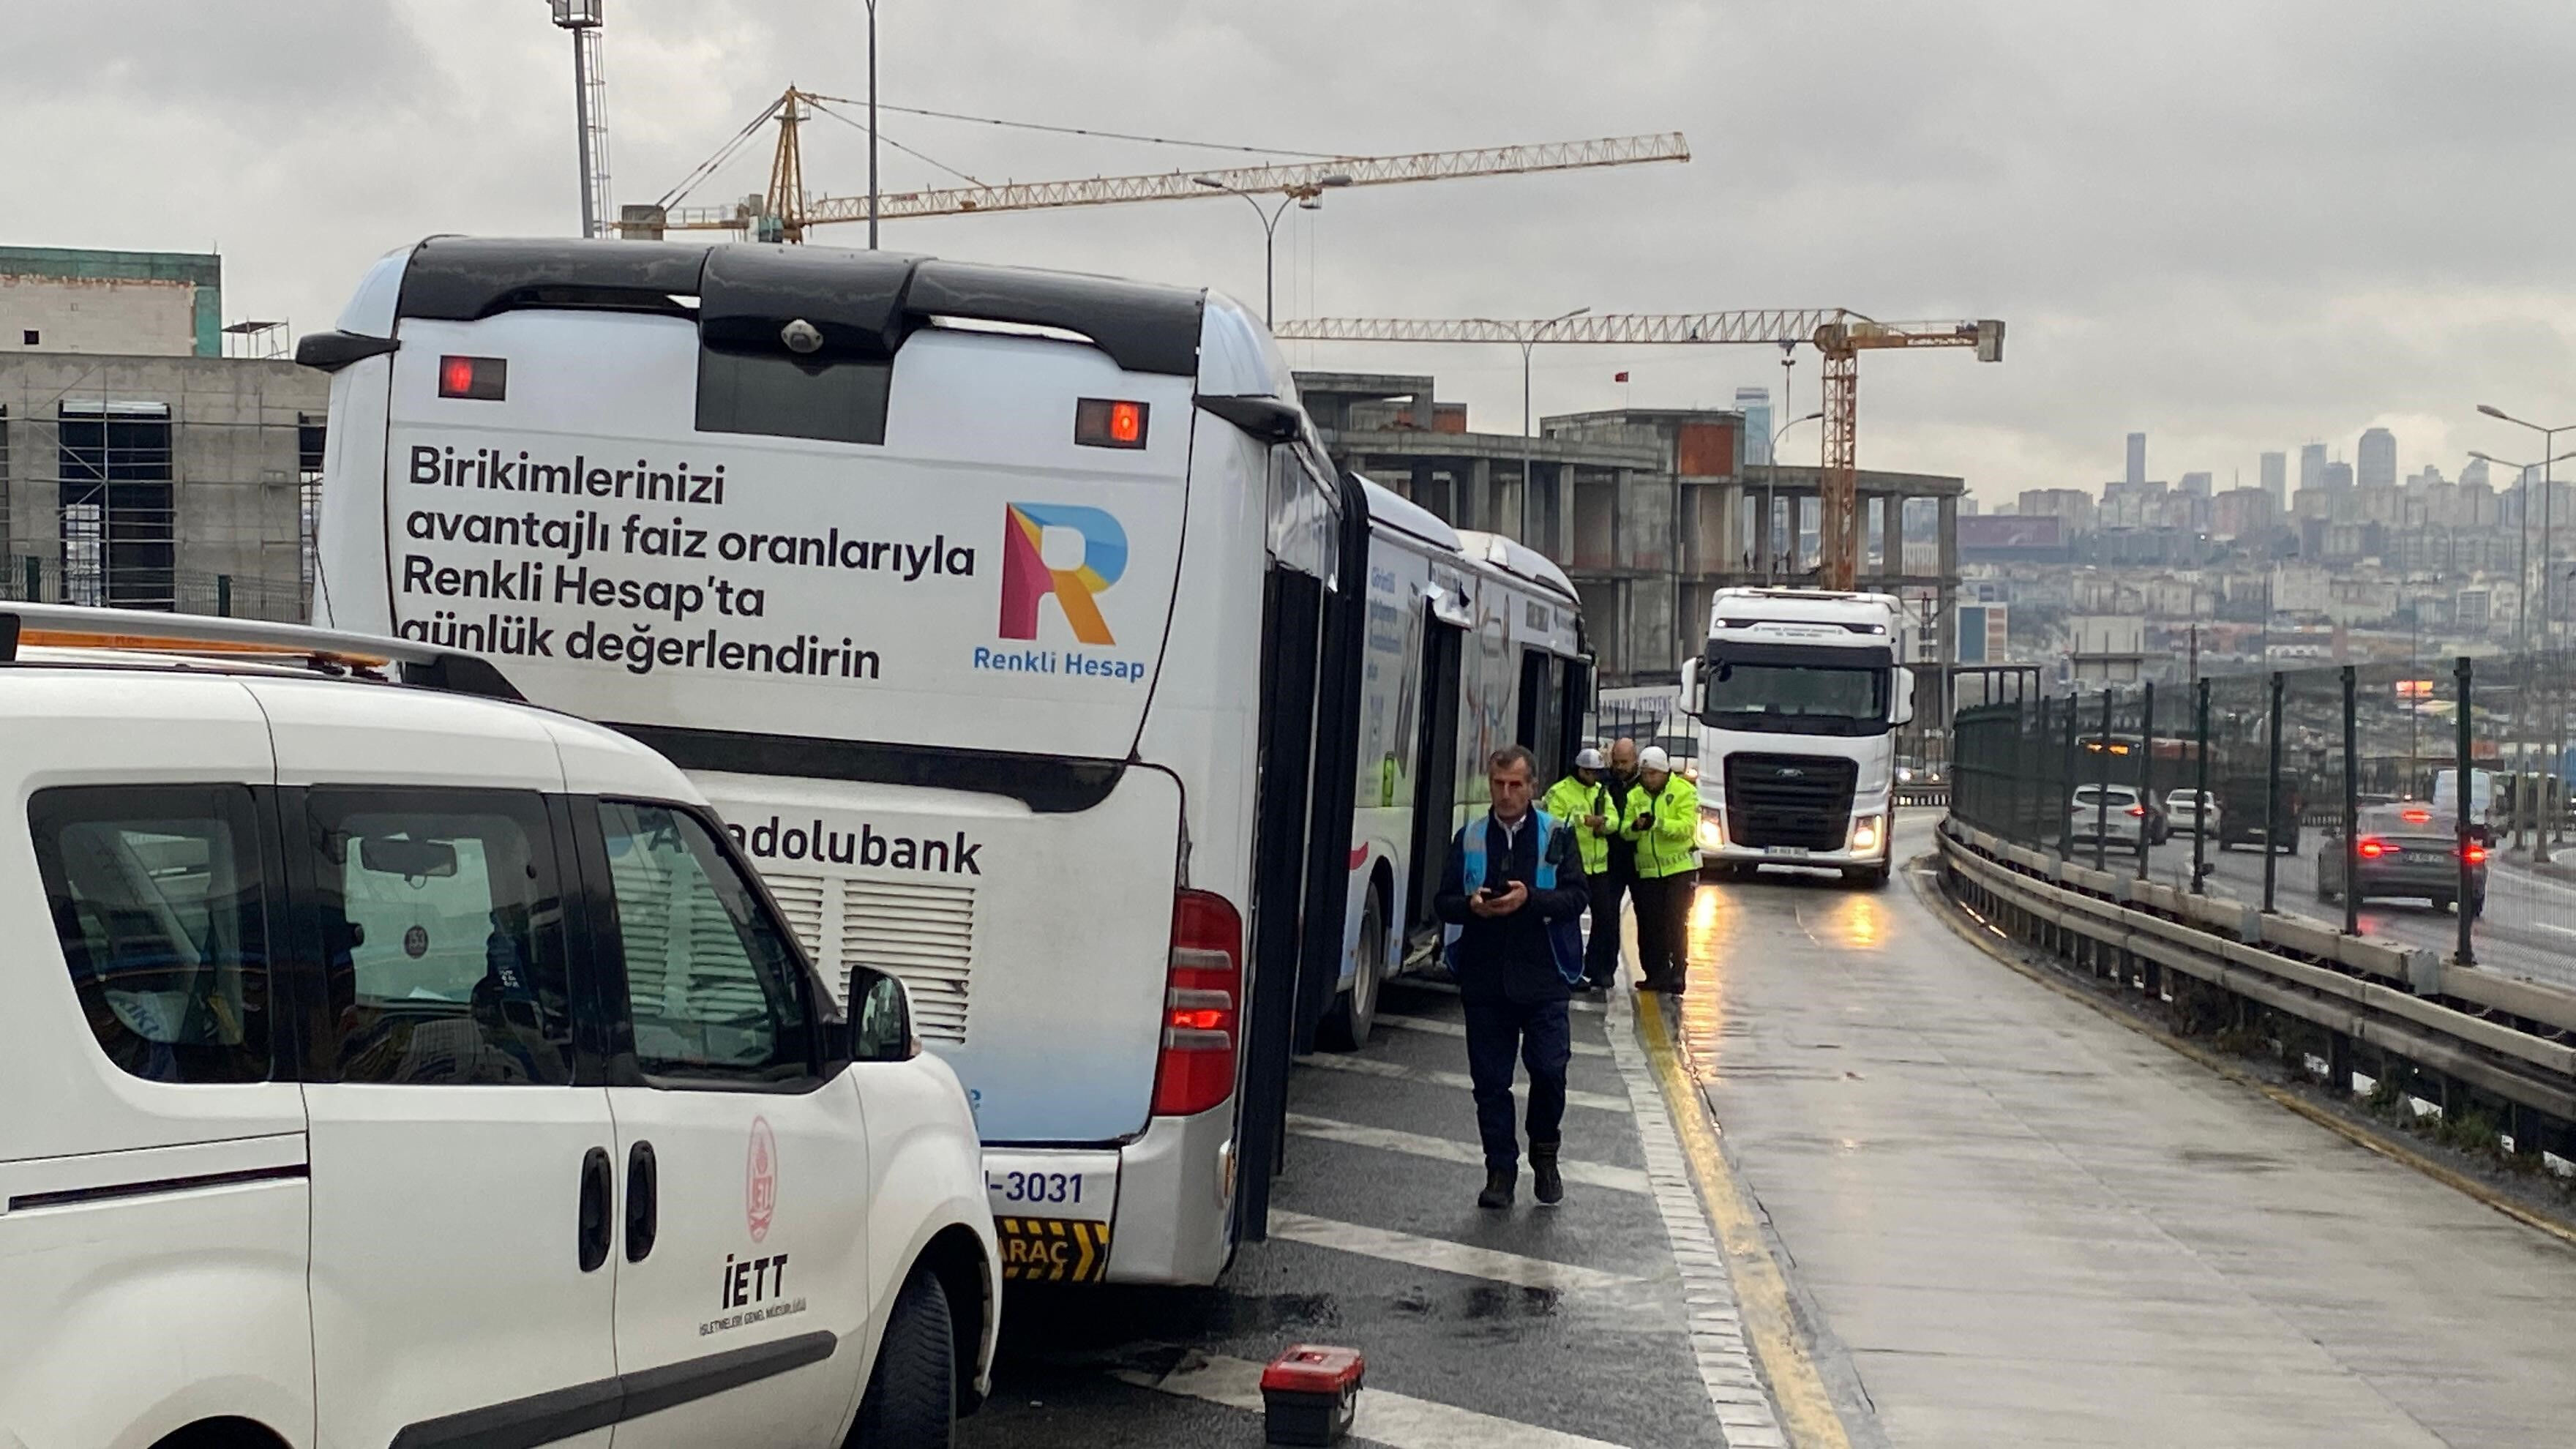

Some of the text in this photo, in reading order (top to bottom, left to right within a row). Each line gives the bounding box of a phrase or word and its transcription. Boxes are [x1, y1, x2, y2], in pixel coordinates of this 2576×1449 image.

[410, 444, 724, 505] Birikimlerinizi
[406, 510, 976, 582] avantajlı faiz oranlarıyla
[402, 554, 765, 621] Renkli Hesap'ta
[566, 620, 880, 680] değerlendirin
[973, 647, 1145, 683] Renkli Hesap
[722, 1253, 789, 1310] İETT
